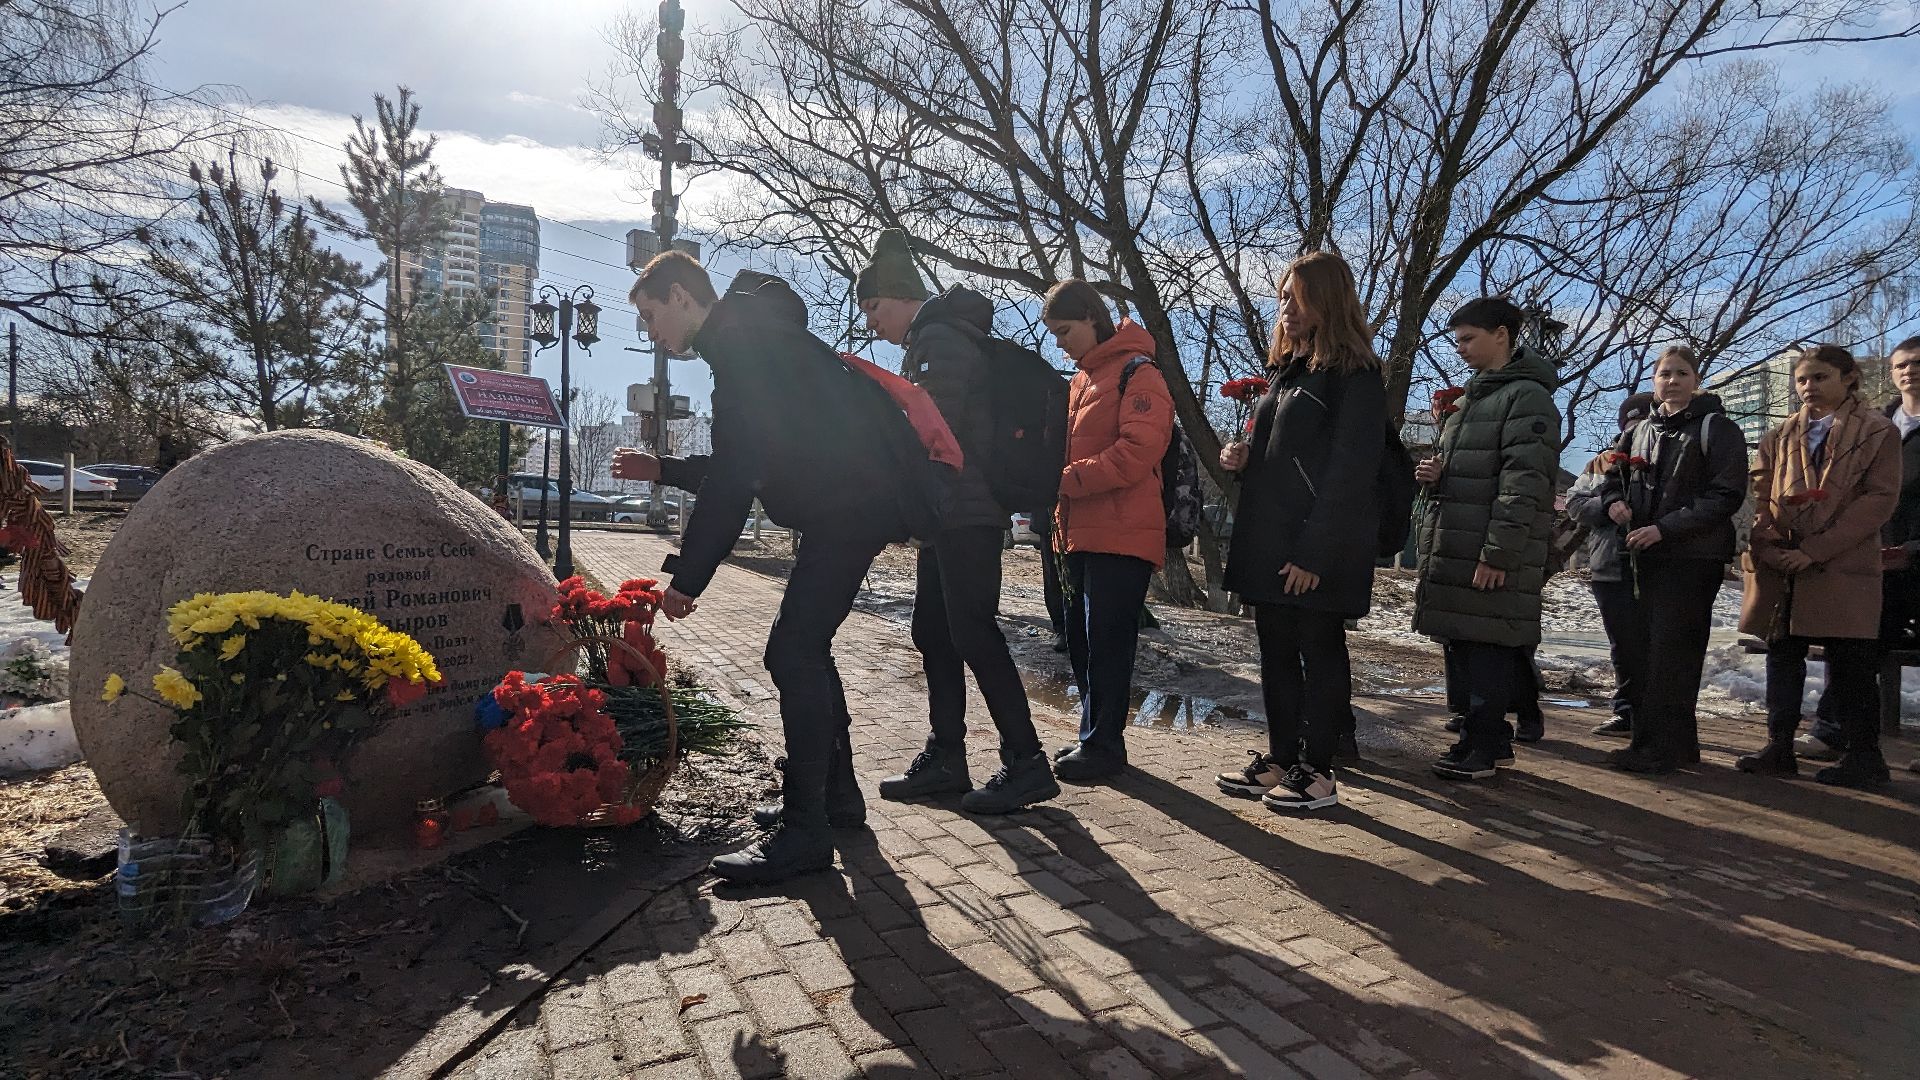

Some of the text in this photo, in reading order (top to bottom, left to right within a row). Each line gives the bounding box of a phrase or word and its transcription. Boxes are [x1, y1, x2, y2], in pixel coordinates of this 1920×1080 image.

[305, 542, 476, 565] Стране Семье Себе
[366, 567, 432, 588] рядовой
[383, 588, 492, 609] Романович
